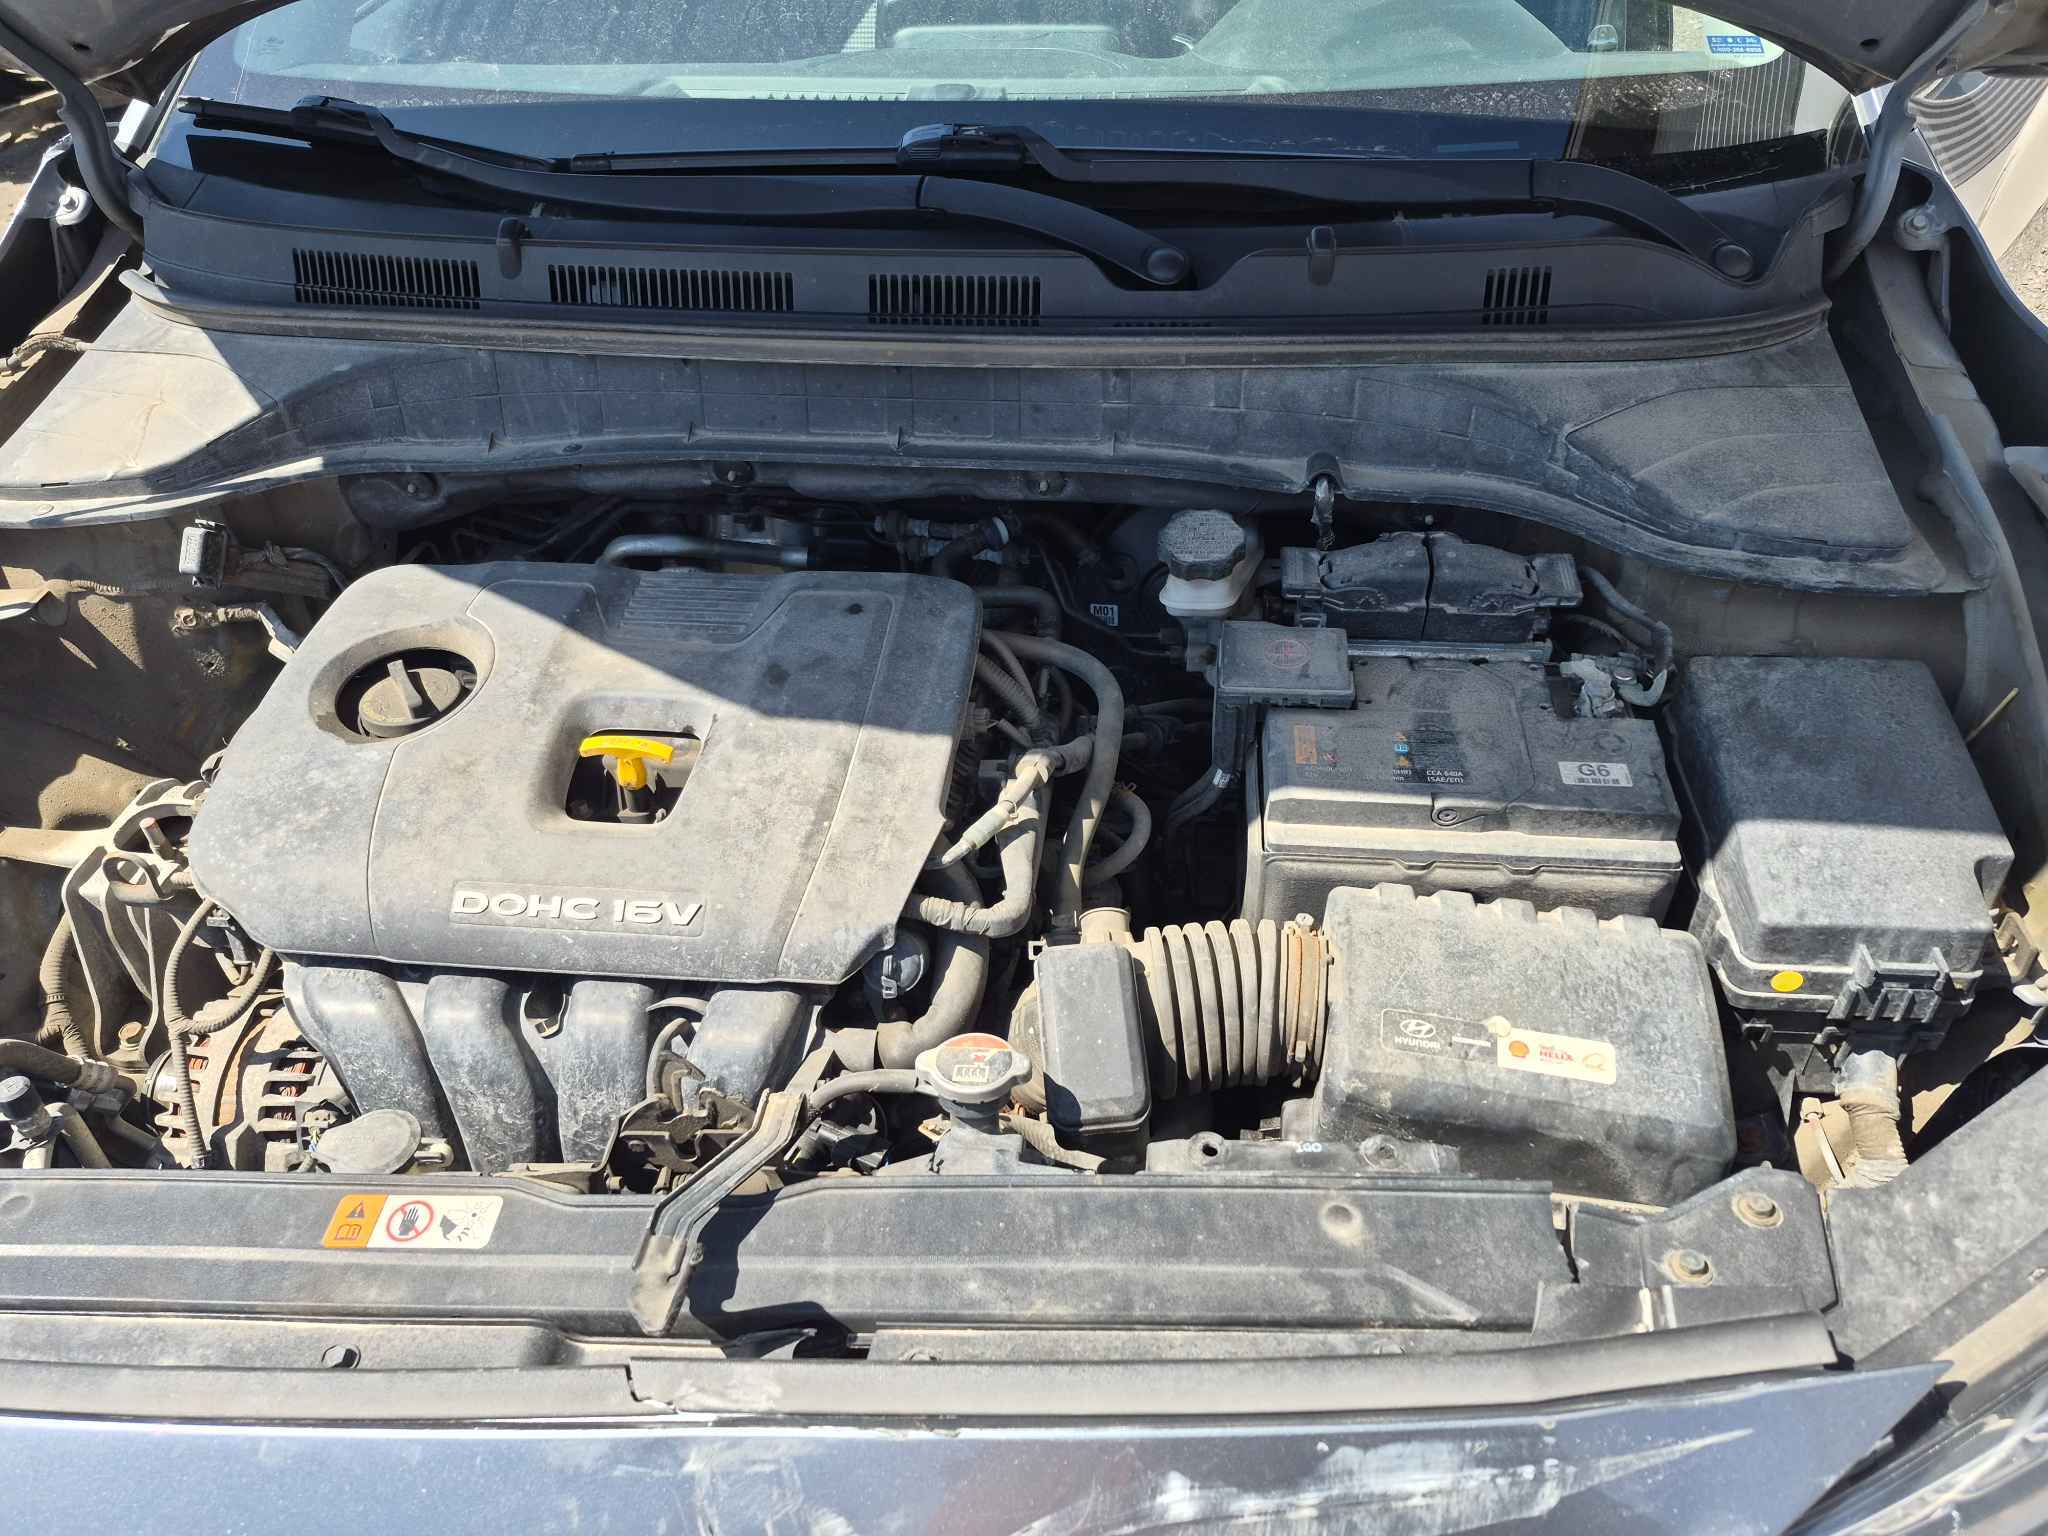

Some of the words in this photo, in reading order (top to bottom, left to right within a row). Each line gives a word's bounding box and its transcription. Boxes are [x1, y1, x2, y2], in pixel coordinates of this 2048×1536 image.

[1578, 763, 1611, 777] G6
[452, 890, 601, 921] DOHC
[614, 898, 703, 927] 16V
[1394, 1036, 1441, 1049] HYUNDAI
